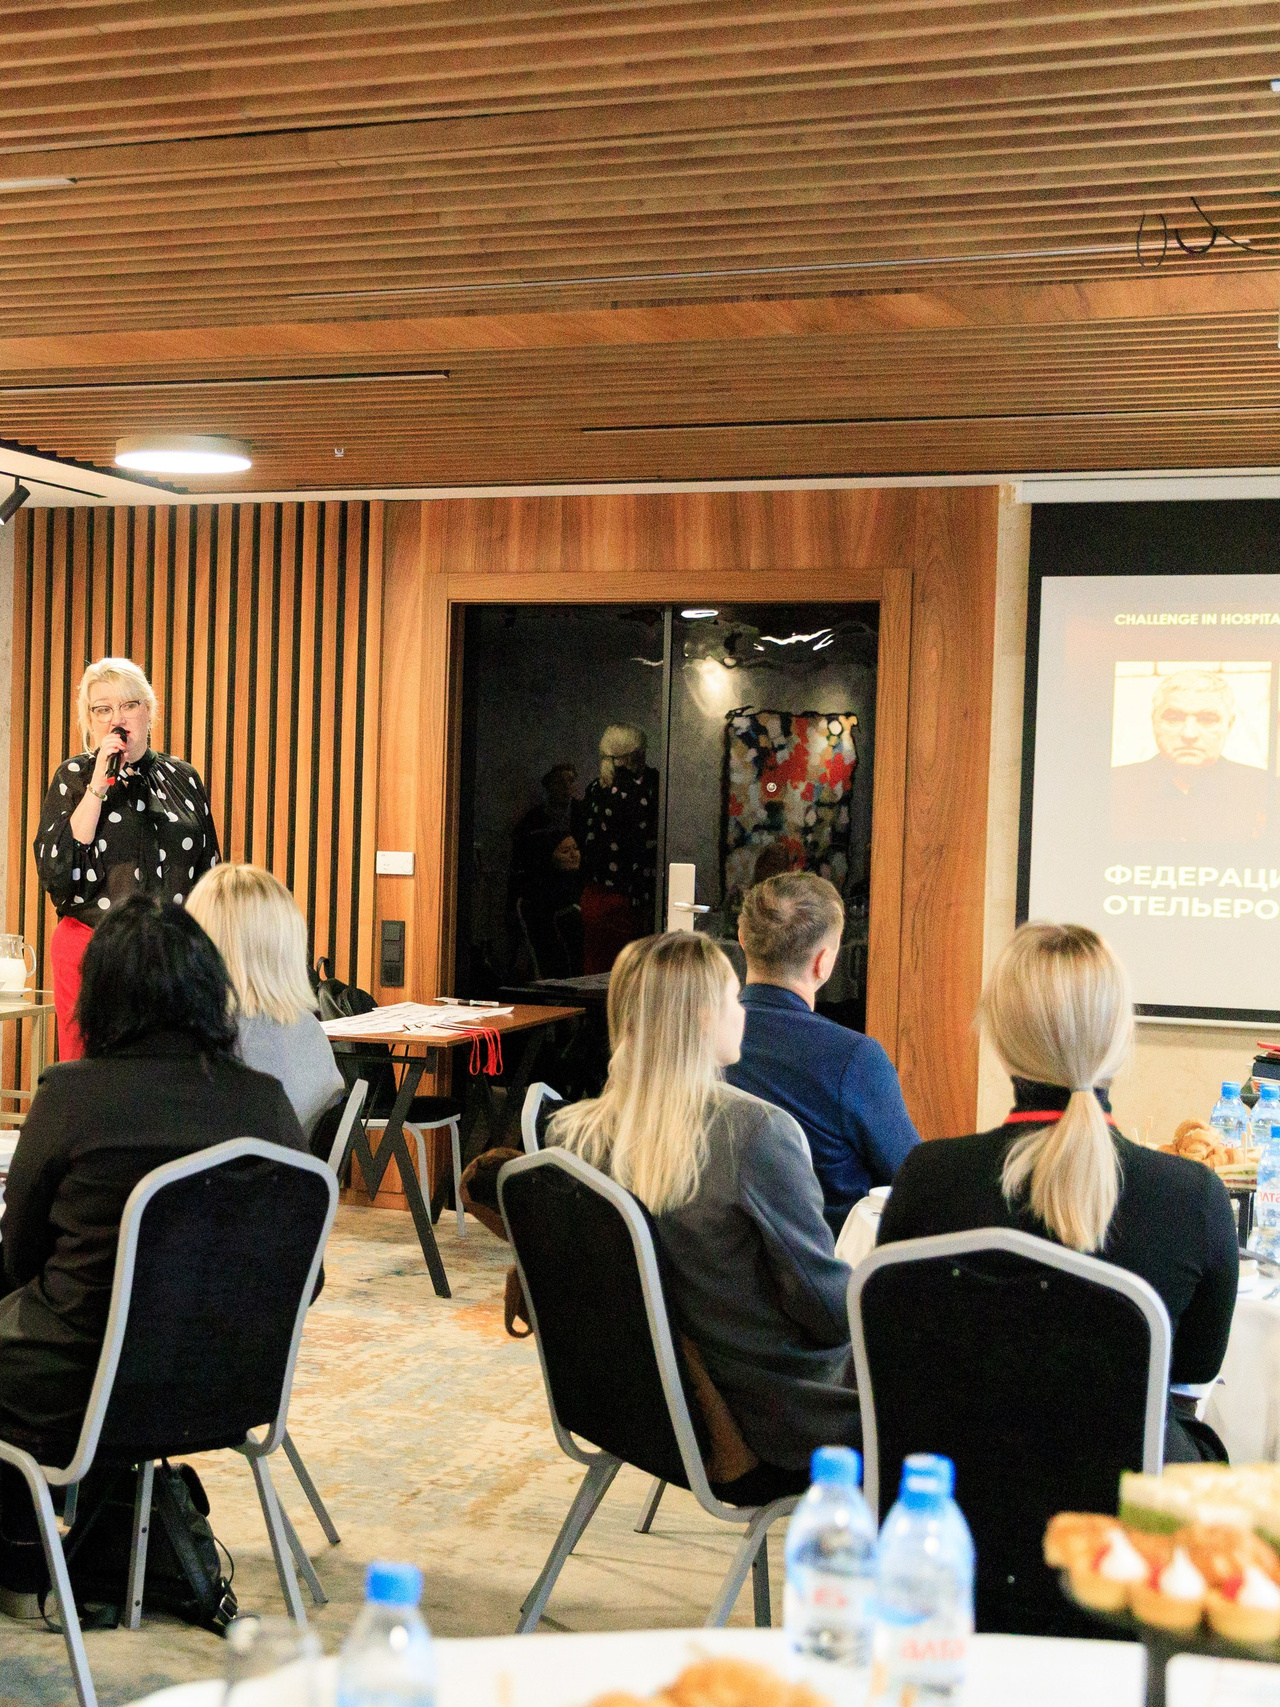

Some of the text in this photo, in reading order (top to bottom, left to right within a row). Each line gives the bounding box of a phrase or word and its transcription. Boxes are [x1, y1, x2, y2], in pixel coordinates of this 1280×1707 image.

[1114, 613, 1199, 626] CHALLENGE
[1201, 613, 1218, 625] IN
[1103, 895, 1280, 919] ОТЕЛЬЕРО
